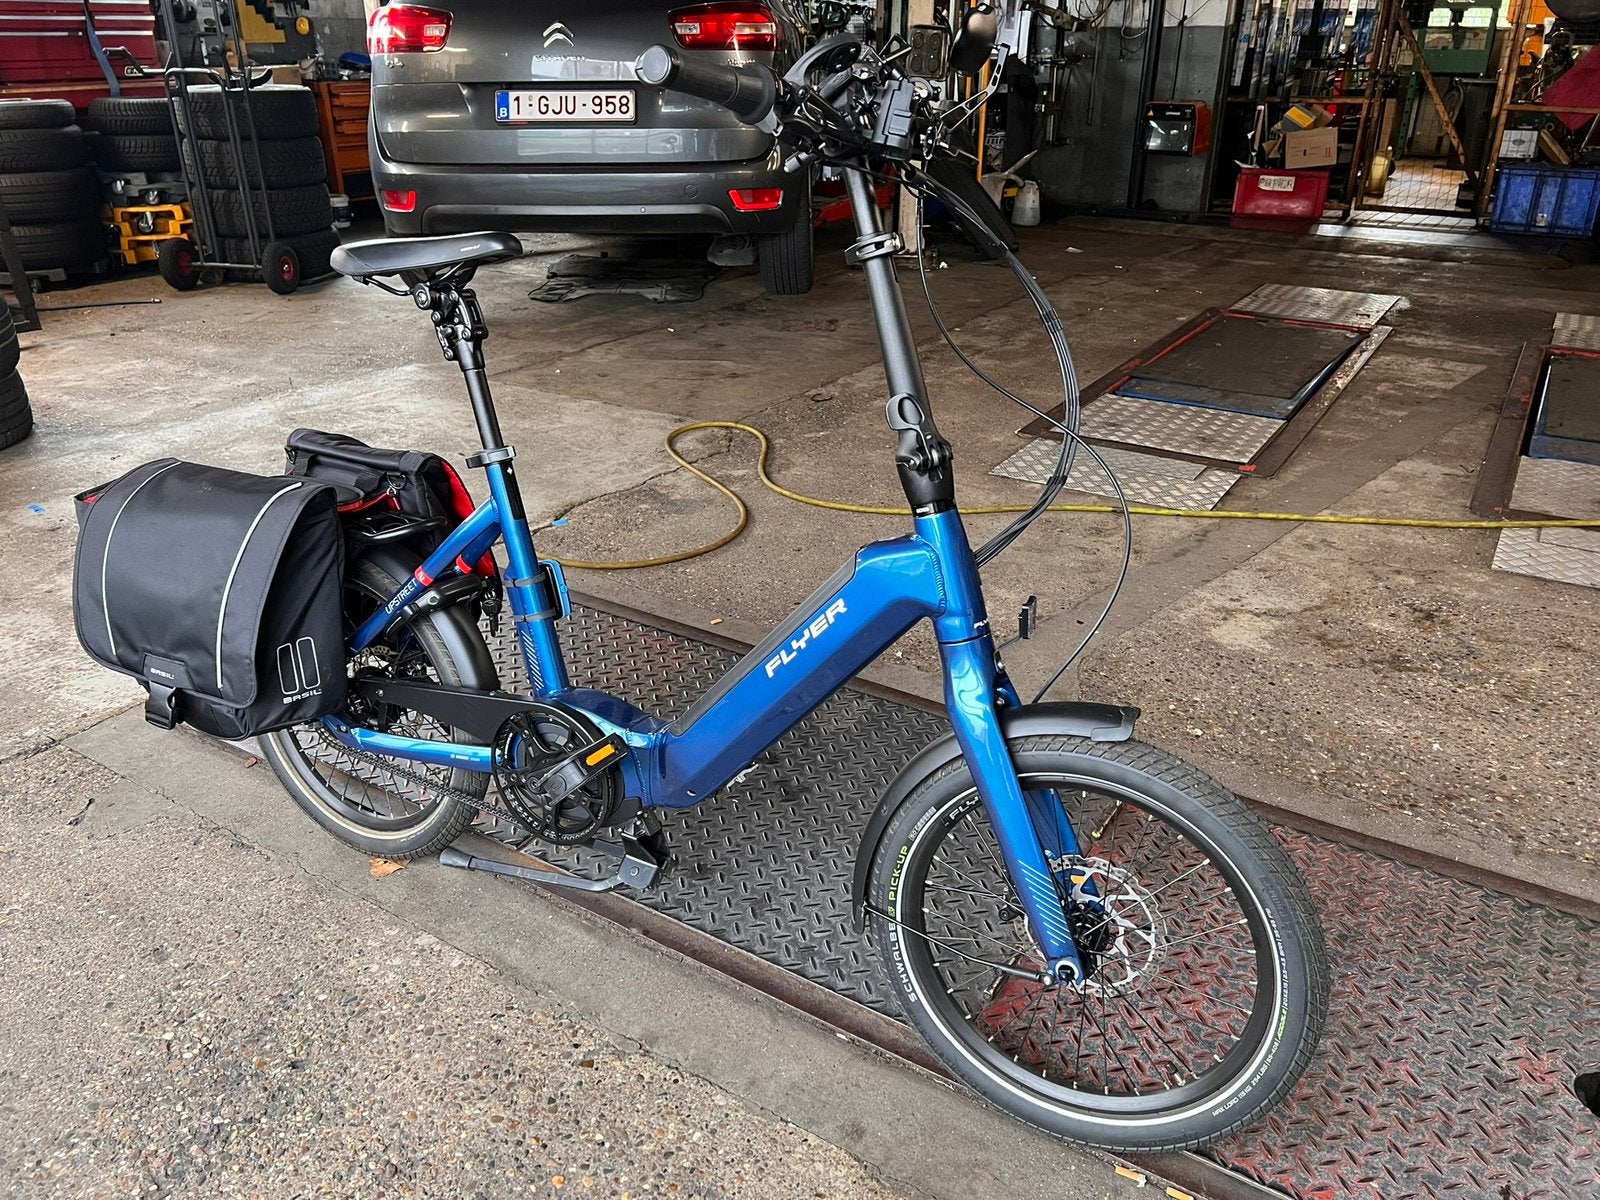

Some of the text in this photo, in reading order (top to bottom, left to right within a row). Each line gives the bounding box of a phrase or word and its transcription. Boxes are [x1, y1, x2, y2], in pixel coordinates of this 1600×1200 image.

[499, 95, 631, 118] B 1-GJU-958
[384, 577, 418, 615] UPSTREET
[764, 598, 848, 679] FLYER
[150, 666, 175, 680] BASIL
[282, 687, 323, 705] BASIL
[948, 795, 980, 821] FLY
[888, 844, 919, 1003] SCHWALBE PICK-UP
